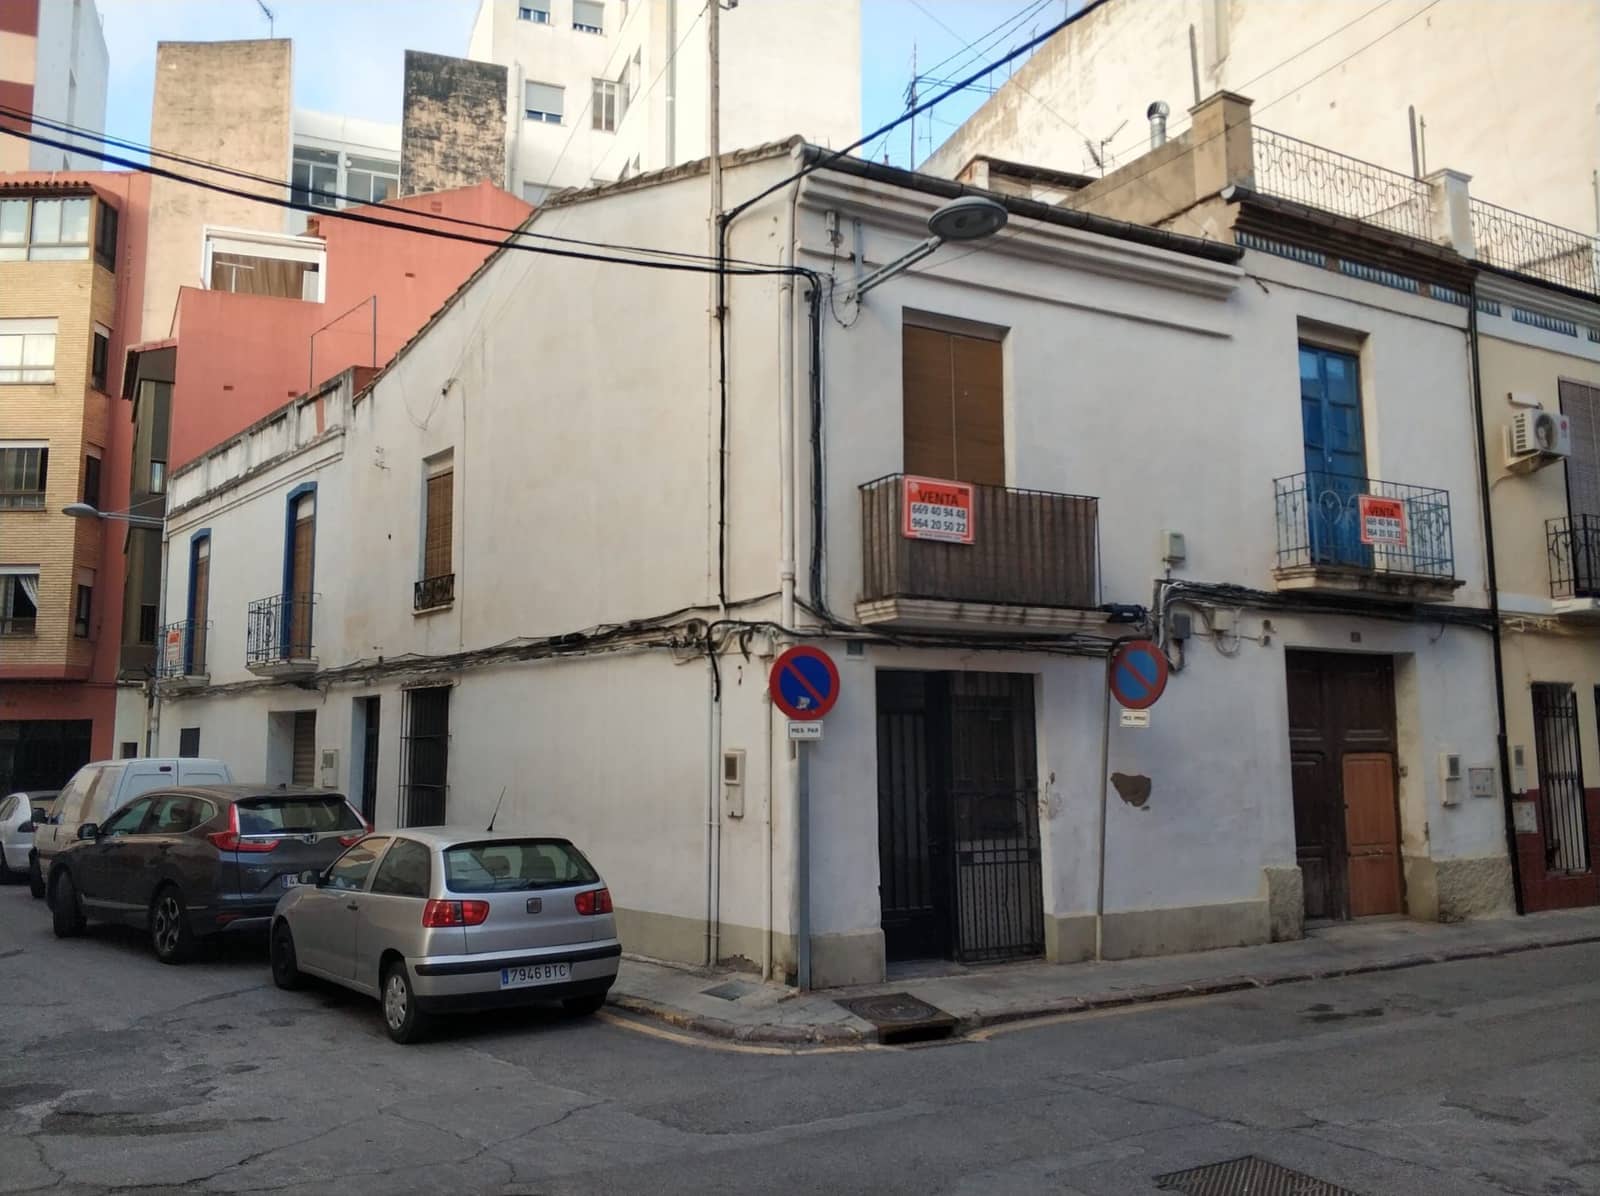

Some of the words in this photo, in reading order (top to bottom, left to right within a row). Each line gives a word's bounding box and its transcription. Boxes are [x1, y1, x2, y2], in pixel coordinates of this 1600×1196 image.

[919, 490, 959, 507] VENTA
[931, 506, 942, 517] 40
[1369, 506, 1395, 517] VENTA
[931, 519, 942, 530] 20
[943, 521, 954, 532] 50
[956, 522, 966, 533] 22
[511, 967, 542, 982] 7946
[544, 964, 566, 979] BTC
